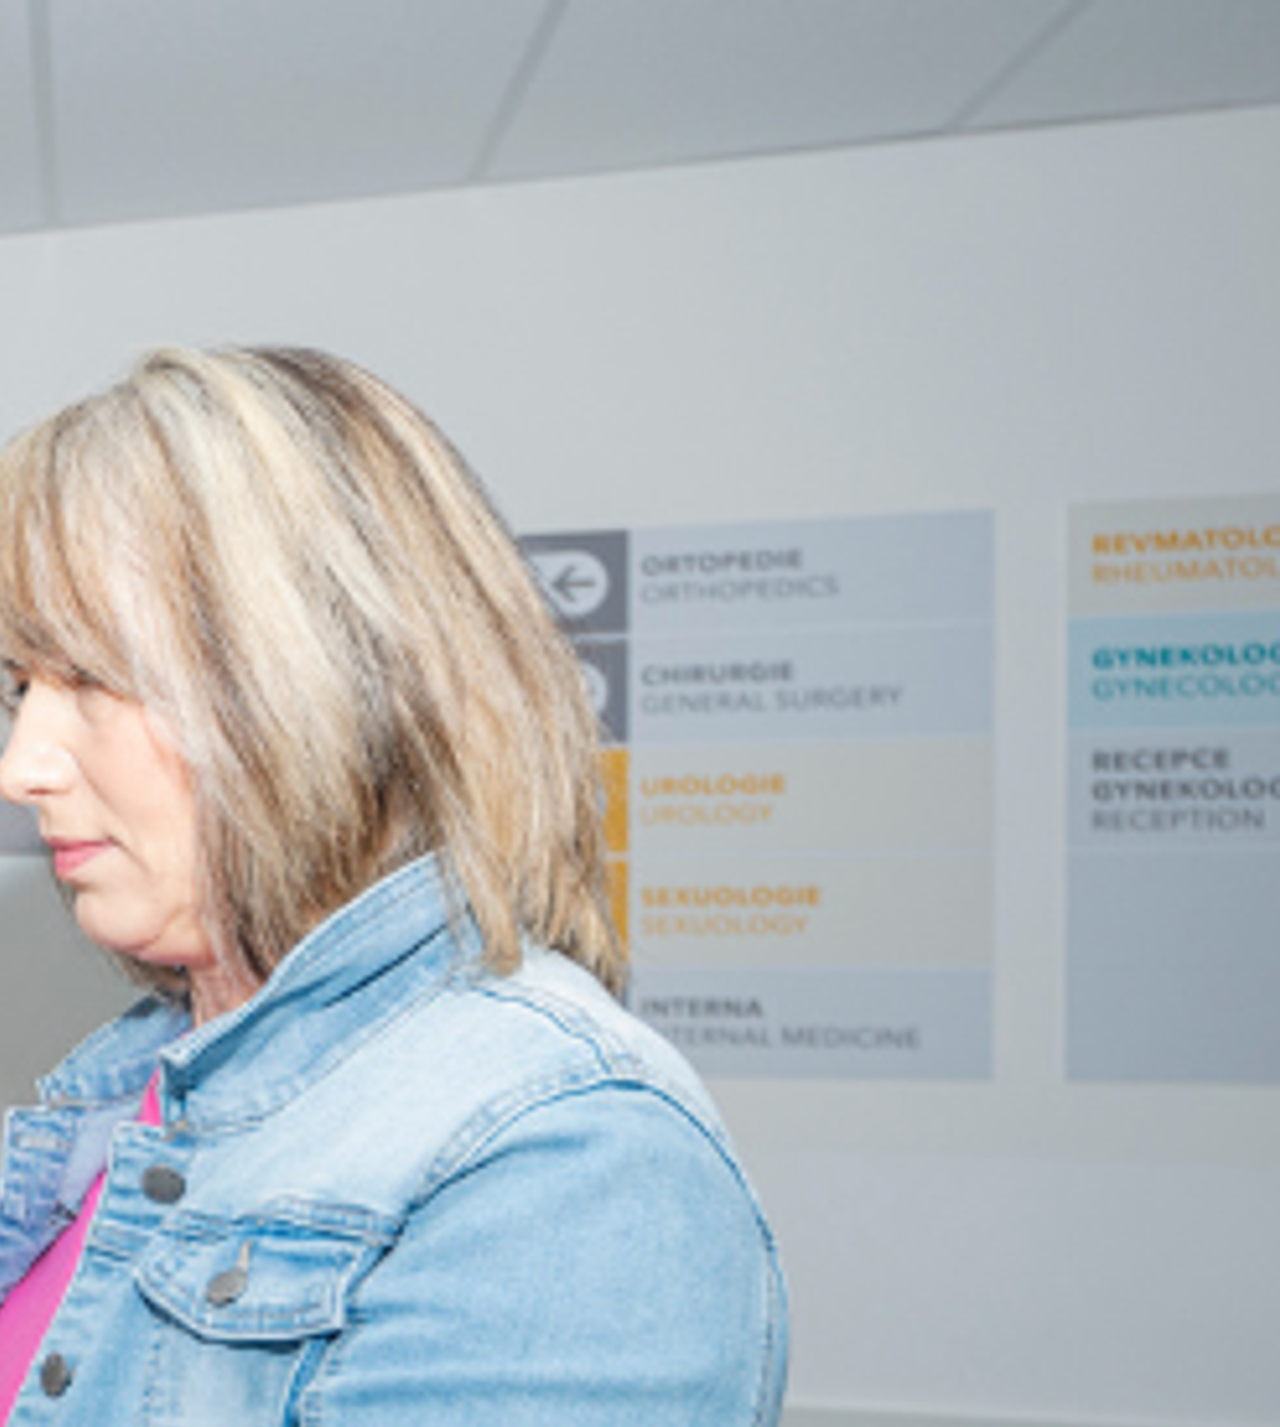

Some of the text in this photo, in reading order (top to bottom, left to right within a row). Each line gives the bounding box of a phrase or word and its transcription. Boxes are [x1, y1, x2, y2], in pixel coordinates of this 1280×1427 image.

[641, 549, 803, 576] ORTOPEDIE
[641, 576, 840, 603] ORTHOPEDICS
[641, 660, 794, 686] CHIRURGIE
[641, 685, 902, 714] GENERAL SURGERY
[1092, 746, 1229, 773] RECEPCE
[641, 773, 786, 798] UROLOGIE
[641, 801, 774, 827] UROLOGY
[1092, 806, 1266, 833] RECEPTION
[641, 884, 820, 909] SEXUOLOGIE
[641, 912, 810, 937] SEXUOLOGY
[642, 997, 764, 1019] INTERNA
[781, 1025, 921, 1050] MEDICINE
